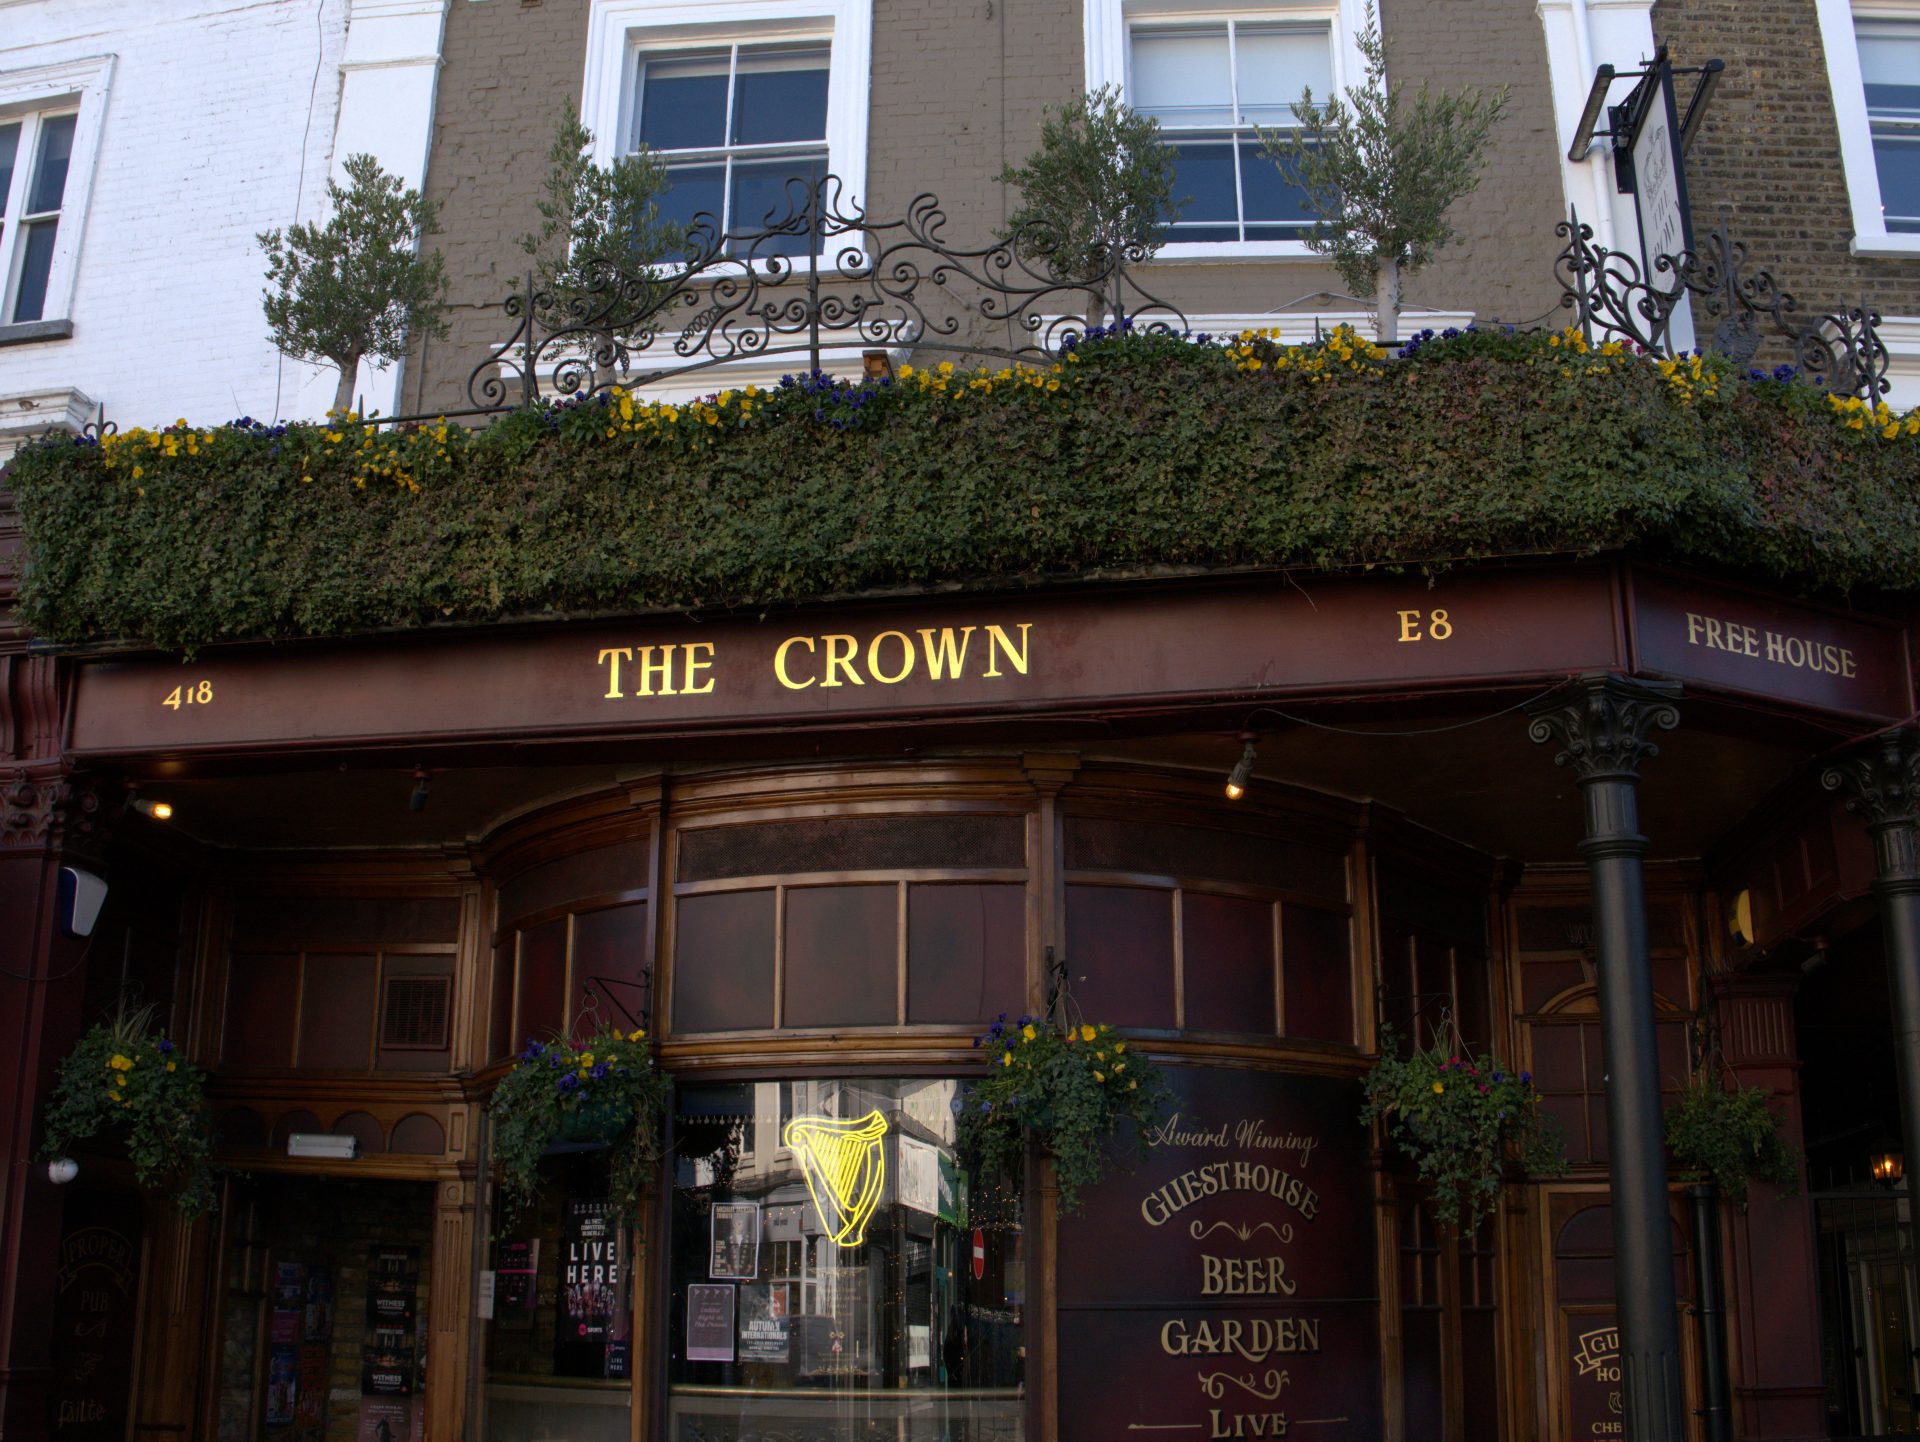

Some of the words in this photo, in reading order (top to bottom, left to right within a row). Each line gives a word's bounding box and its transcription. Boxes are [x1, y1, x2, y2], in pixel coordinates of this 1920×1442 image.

[1397, 609, 1453, 643] E8
[597, 641, 716, 699] THE
[773, 623, 1033, 690] CROWN
[1686, 612, 1760, 658] FREE
[1765, 632, 1858, 679] HOUSE
[162, 680, 213, 710] 418
[1148, 1112, 1229, 1148] Award
[1235, 1119, 1319, 1167] Winning
[571, 1242, 615, 1261] LIVE
[567, 1264, 618, 1284] HERE
[1201, 1254, 1296, 1295] BEER
[80, 1290, 109, 1312] PUB
[1160, 1317, 1320, 1363] GARDEN
[1209, 1409, 1288, 1438] LIVE
